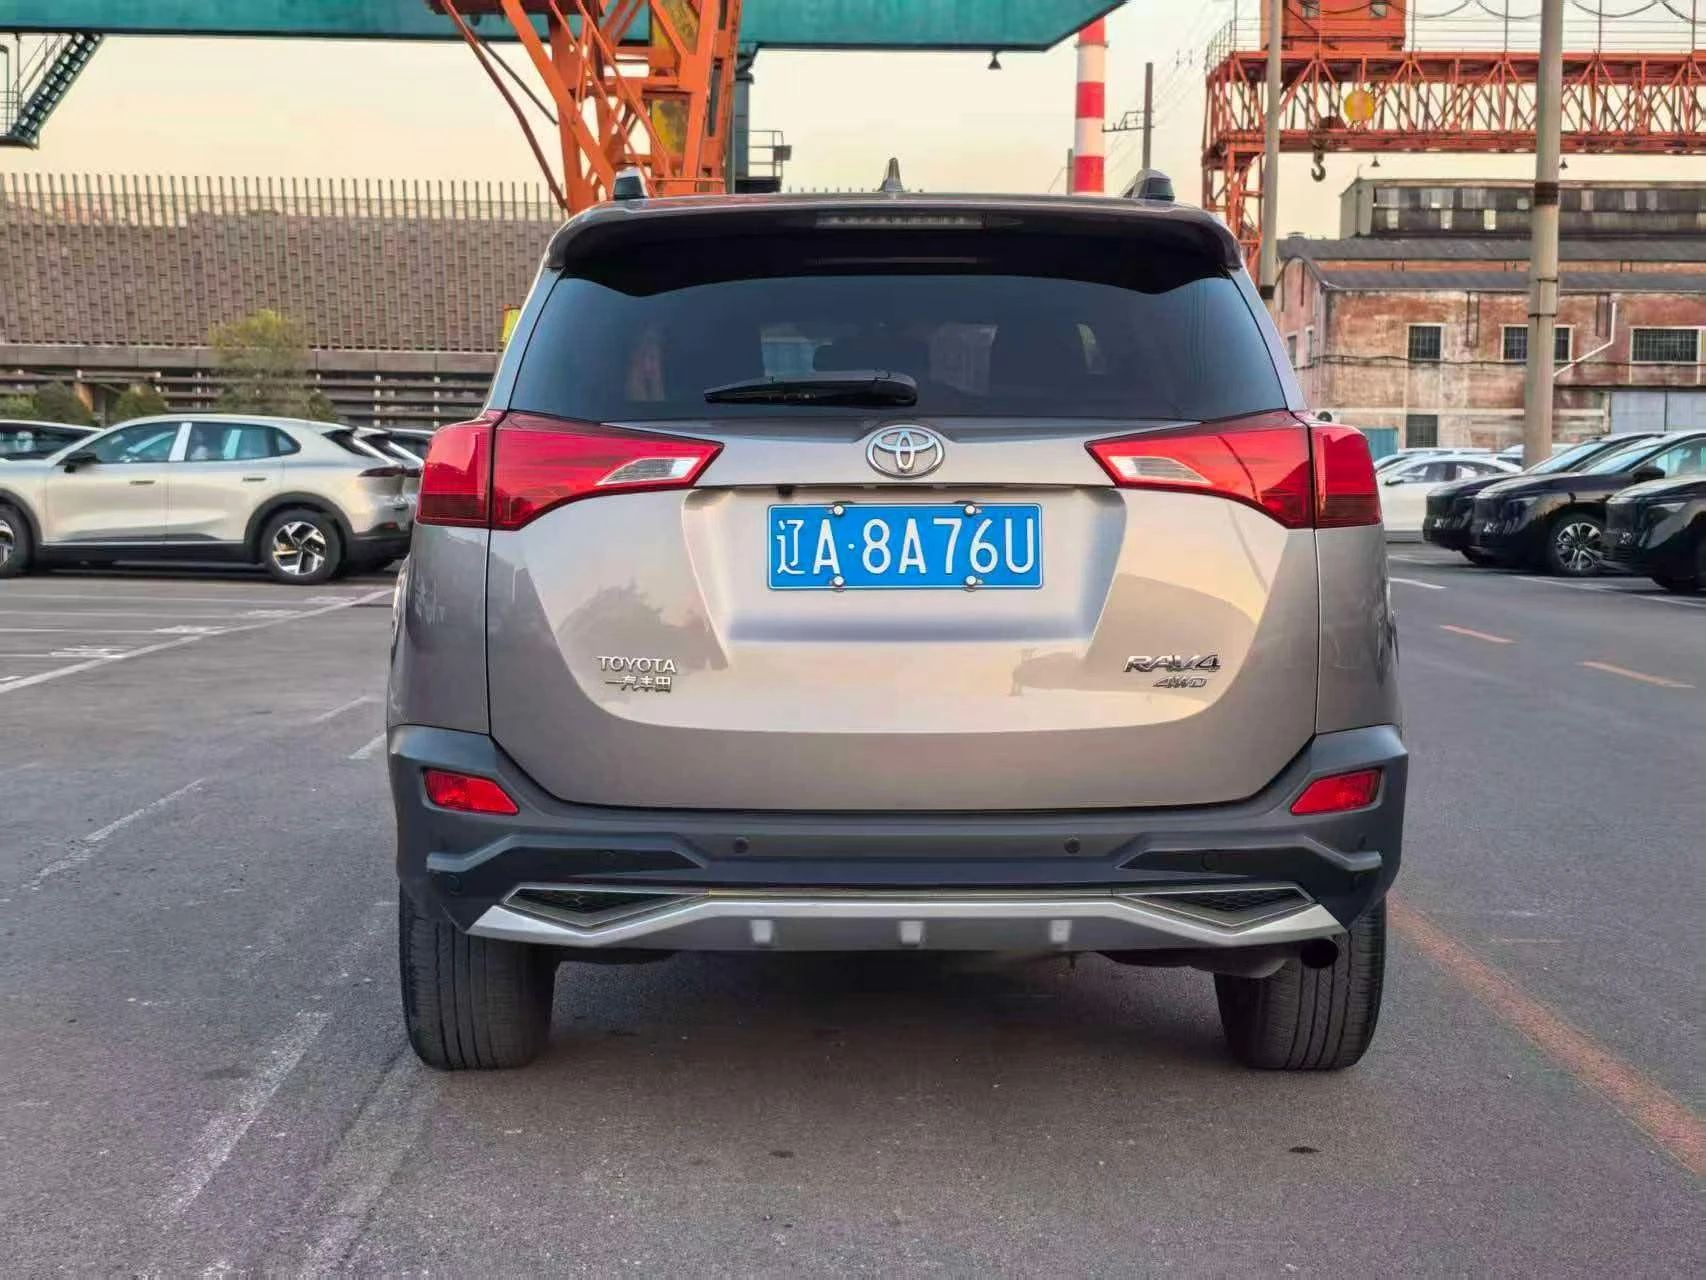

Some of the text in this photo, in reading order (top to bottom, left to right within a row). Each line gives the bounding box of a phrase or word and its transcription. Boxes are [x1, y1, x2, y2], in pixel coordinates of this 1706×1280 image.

[777, 518, 1034, 574] 辽A·8A76U
[597, 655, 677, 673] TOYOTA
[1123, 655, 1221, 672] RAV4
[604, 674, 671, 693] 一汽丰田
[1152, 676, 1207, 688] 4WD
